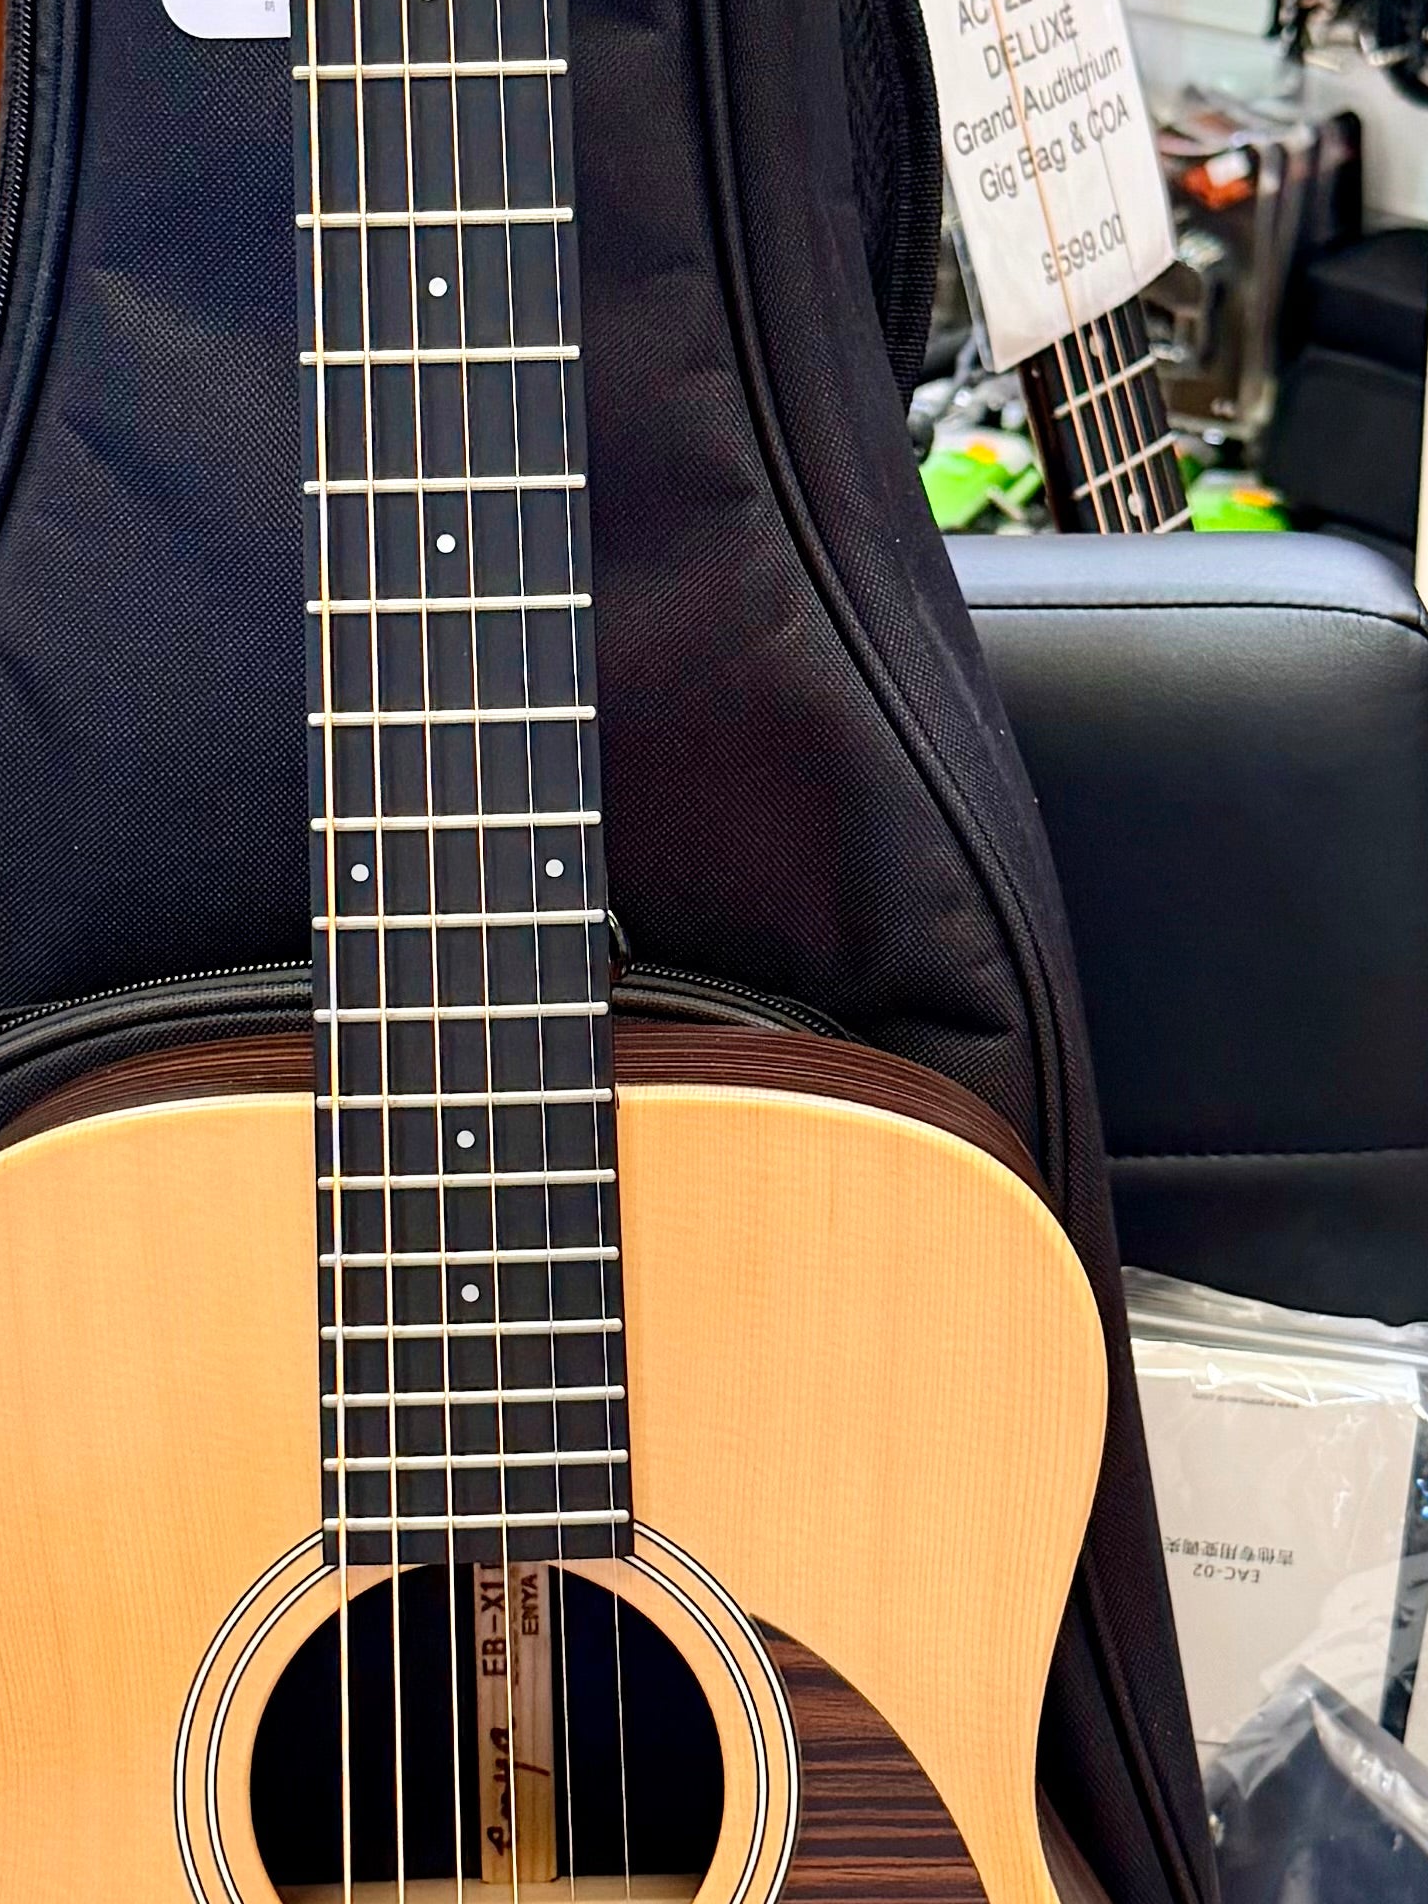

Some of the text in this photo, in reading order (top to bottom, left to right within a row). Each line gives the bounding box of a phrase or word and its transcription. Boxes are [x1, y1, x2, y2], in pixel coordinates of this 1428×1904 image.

[983, 4, 1079, 80] DELUXE
[952, 45, 1123, 156] Grand Auditorium
[979, 92, 1131, 202] Gig Bag & COA
[522, 1572, 540, 1636] ENYA
[1192, 1562, 1261, 1584] EAC-02
